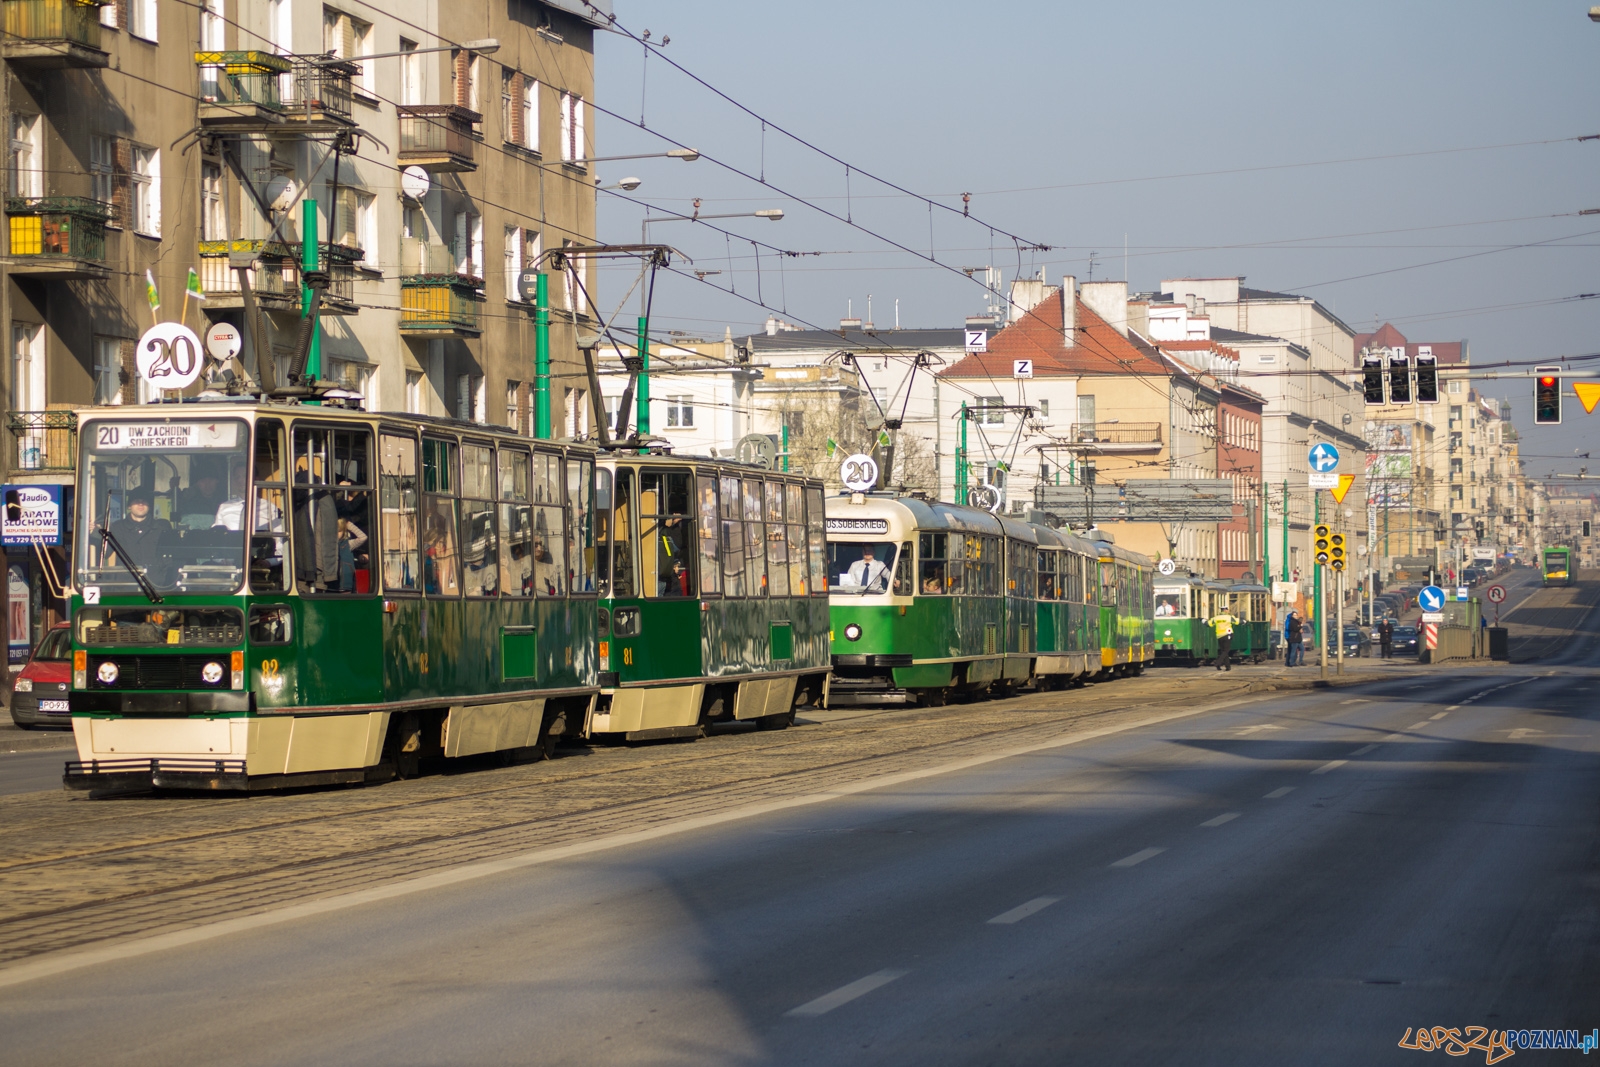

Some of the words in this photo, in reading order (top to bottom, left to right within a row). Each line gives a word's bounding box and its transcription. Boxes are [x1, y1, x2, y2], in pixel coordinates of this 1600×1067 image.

[970, 333, 982, 345] Z
[146, 334, 196, 379] 20
[1018, 362, 1029, 373] Z
[99, 426, 120, 446] 20
[147, 426, 191, 437] ZACHODNI
[130, 437, 189, 447] SOBIESKIEGO
[846, 460, 874, 484] 20
[1161, 562, 1174, 572] 20
[88, 592, 96, 601] 7
[623, 647, 633, 665] 81
[261, 658, 279, 680] 82
[420, 652, 429, 674] 82
[43, 701, 54, 710] PO
